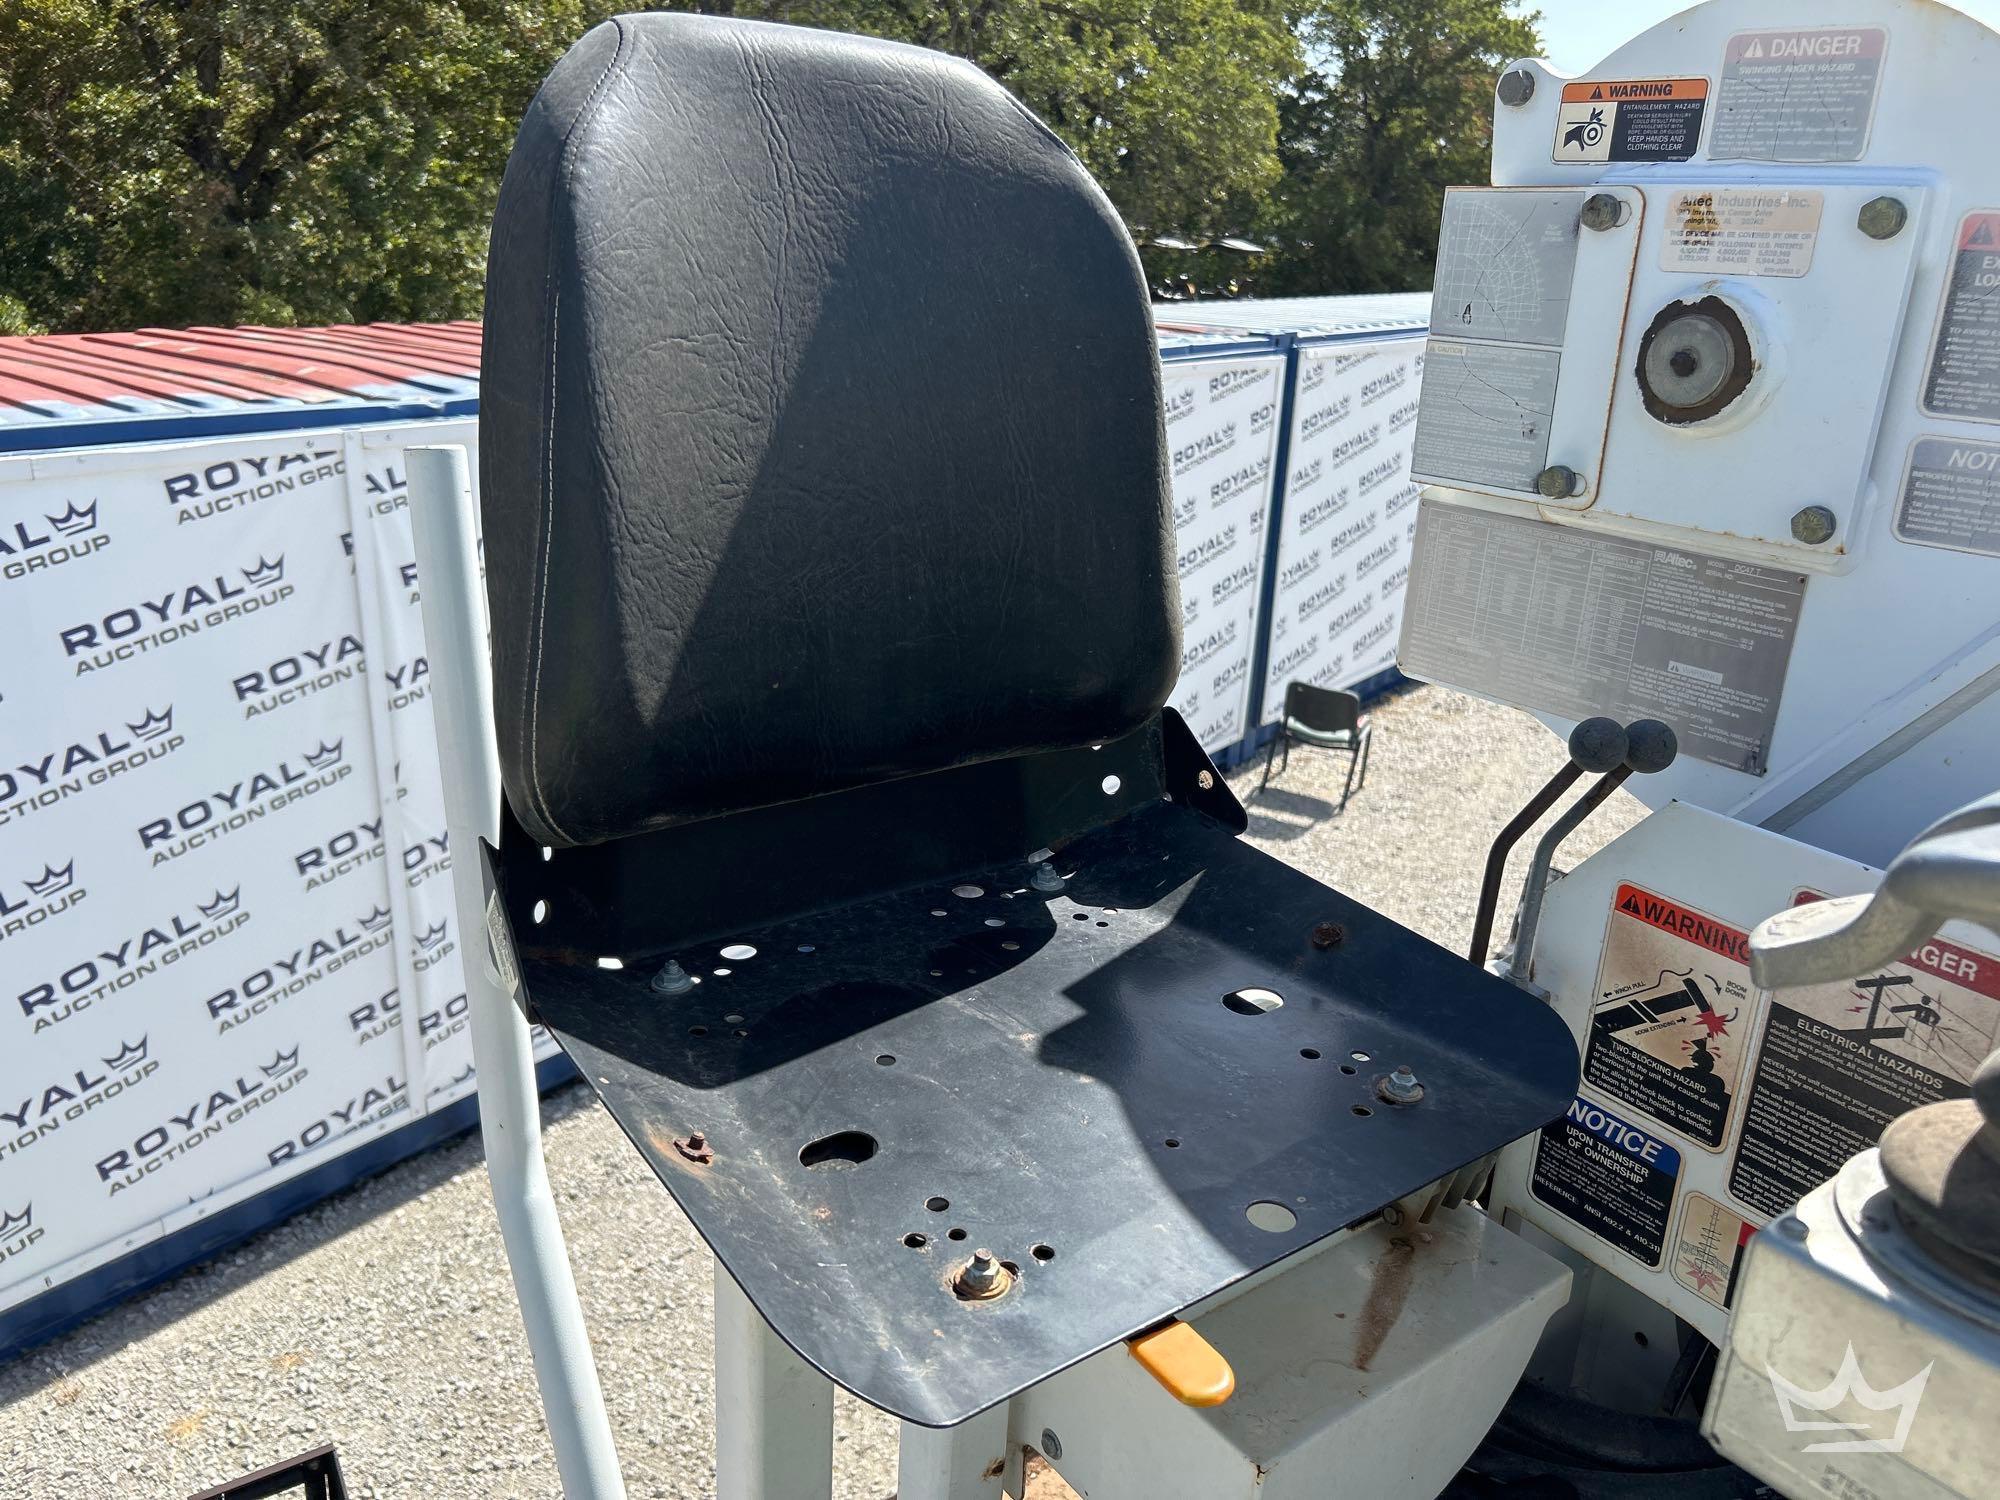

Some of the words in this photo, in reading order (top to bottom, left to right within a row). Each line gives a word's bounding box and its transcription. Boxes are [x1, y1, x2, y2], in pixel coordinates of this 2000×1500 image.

[1769, 35, 1862, 58] DANGER
[1738, 65, 1783, 74] SWINGING
[1784, 64, 1815, 73] AUGER
[1817, 63, 1856, 72] HAZARD
[1609, 84, 1673, 98] WARNING
[1622, 103, 1671, 111] ENTANGLEMENT
[1627, 135, 1645, 143] KEEP
[1627, 143, 1659, 151] CLOTHING
[1660, 143, 1683, 151] CLEAR
[1717, 195, 1781, 208] Industries
[1786, 196, 1810, 208] Inc.
[1361, 370, 1396, 398] ROYAL
[1301, 401, 1339, 433] ROYAL
[1174, 431, 1223, 467] ROYAL
[1332, 430, 1369, 461] ROYAL
[1947, 448, 2000, 471] NOT
[1210, 464, 1257, 500] ROYAL
[1359, 457, 1393, 488] ROYAL
[178, 476, 294, 525] AUCTION
[1299, 494, 1337, 527] ROYAL
[1331, 518, 1367, 550] ROYAL
[3, 534, 112, 580] GROUP
[1356, 541, 1390, 572] ROYAL
[1665, 552, 1694, 569] Altec
[1298, 580, 1335, 615] ROYAL
[60, 576, 246, 657] ROYAL
[75, 620, 200, 677] AUCTION
[205, 584, 294, 628] GROUP
[1329, 601, 1363, 633] ROYAL
[1352, 621, 1385, 653] ROYAL
[232, 634, 365, 702] ROYA
[245, 665, 353, 720] AUCTION
[0, 779, 82, 827] CTION
[87, 735, 186, 786] GROUP
[138, 763, 307, 851] ROYAL
[152, 804, 266, 869] AUCTION
[269, 764, 352, 812] GROUP
[295, 816, 383, 876] ROY
[17, 915, 202, 1018] ROYAL
[34, 960, 157, 1035] AUCTION
[161, 911, 250, 966] GROUP
[206, 928, 361, 1020] ROYAL
[218, 969, 322, 1036] AUCTION
[326, 932, 395, 975] GROU
[1613, 984, 1633, 995] WINCH
[1632, 981, 1647, 991] PULL
[1724, 986, 1746, 1000] DOWN
[1726, 980, 1748, 993] BOOM
[1634, 1026, 1650, 1036] BOOM
[1649, 1019, 1677, 1033] EXTENDING
[1601, 1054, 1624, 1071] serious
[1625, 1066, 1643, 1081] injury
[1612, 1040, 1671, 1077] TWO-BLOCKING
[1672, 1071, 1706, 1094] HAZARD
[1762, 1055, 1784, 1070] NEVER
[1797, 1017, 1874, 1061] ELECTRICAL
[1877, 1052, 1943, 1091] HAZARDS
[64, 1060, 161, 1122] GROUP
[1588, 1074, 1595, 1082] or
[1596, 1078, 1622, 1097] lowering
[1624, 1092, 1634, 1102] the
[1590, 1066, 1600, 1076] the
[1601, 1072, 1619, 1086] boom
[1619, 1082, 1628, 1092] tip
[1629, 1087, 1647, 1101] when
[1590, 1059, 1608, 1073] Never
[1610, 1068, 1626, 1082] allow
[1628, 1078, 1638, 1088] the
[1639, 1084, 1655, 1097] hook
[1657, 1093, 1675, 1107] block
[1677, 1103, 1684, 1112] to
[1685, 1107, 1711, 1126] contact
[1595, 1042, 1635, 1068] Two-blocking
[1636, 1064, 1647, 1074] the
[1648, 1070, 1661, 1081] unit
[1662, 1078, 1675, 1089] may
[1677, 1085, 1698, 1100] cause
[1699, 1096, 1719, 1111] death
[0, 1070, 107, 1130] YAL
[1757, 1085, 1770, 1096] This
[1770, 1092, 1782, 1102] unit
[1783, 1098, 1794, 1107] will
[1794, 1104, 1805, 1113] not
[1806, 1109, 1830, 1125] provide
[1831, 1121, 1863, 1141] protection
[95, 1077, 264, 1183] ROYAL
[109, 1120, 223, 1198] AUCTION
[226, 1068, 309, 1124] GROUP
[266, 1076, 408, 1168] ROYAL
[1566, 1099, 1663, 1163] NOTICE
[1566, 1125, 1594, 1147] UPON
[1596, 1141, 1649, 1178] TRANSFER
[1567, 1137, 1583, 1150] OF
[1584, 1146, 1644, 1184] OWNERSHIP
[1774, 1134, 1787, 1145] may
[1787, 1140, 1812, 1156] become
[1737, 1161, 1763, 1177] Maintain
[1763, 1175, 1791, 1192] minimum
[1740, 1148, 1776, 1169] government
[1776, 1166, 1811, 1187] regulations
[1583, 1203, 1601, 1218] ANSI
[1602, 1215, 1624, 1232] A92.2
[1634, 1233, 1661, 1254] A10.31)
